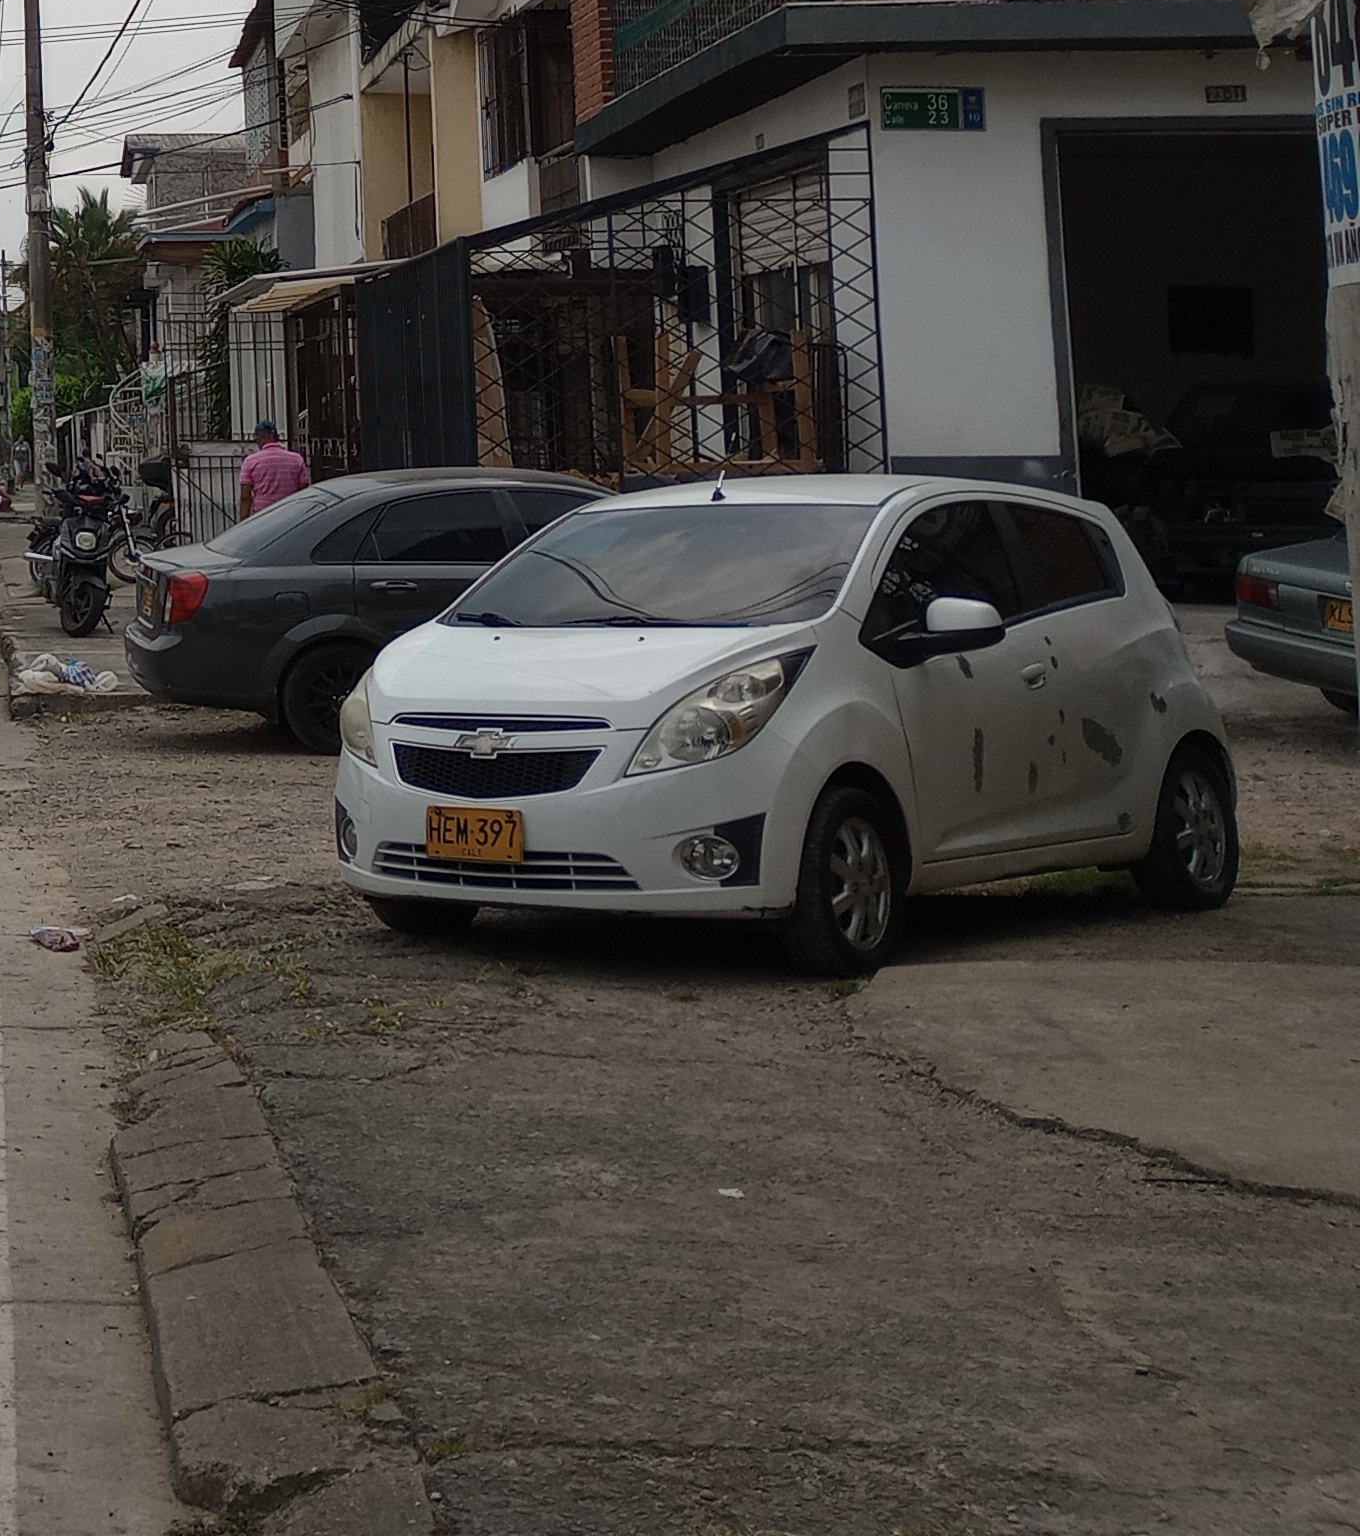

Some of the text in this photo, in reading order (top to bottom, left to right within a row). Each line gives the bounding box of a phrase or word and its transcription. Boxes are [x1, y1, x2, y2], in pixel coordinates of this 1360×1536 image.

[884, 93, 949, 111] Carrera 36
[928, 111, 949, 125] 23
